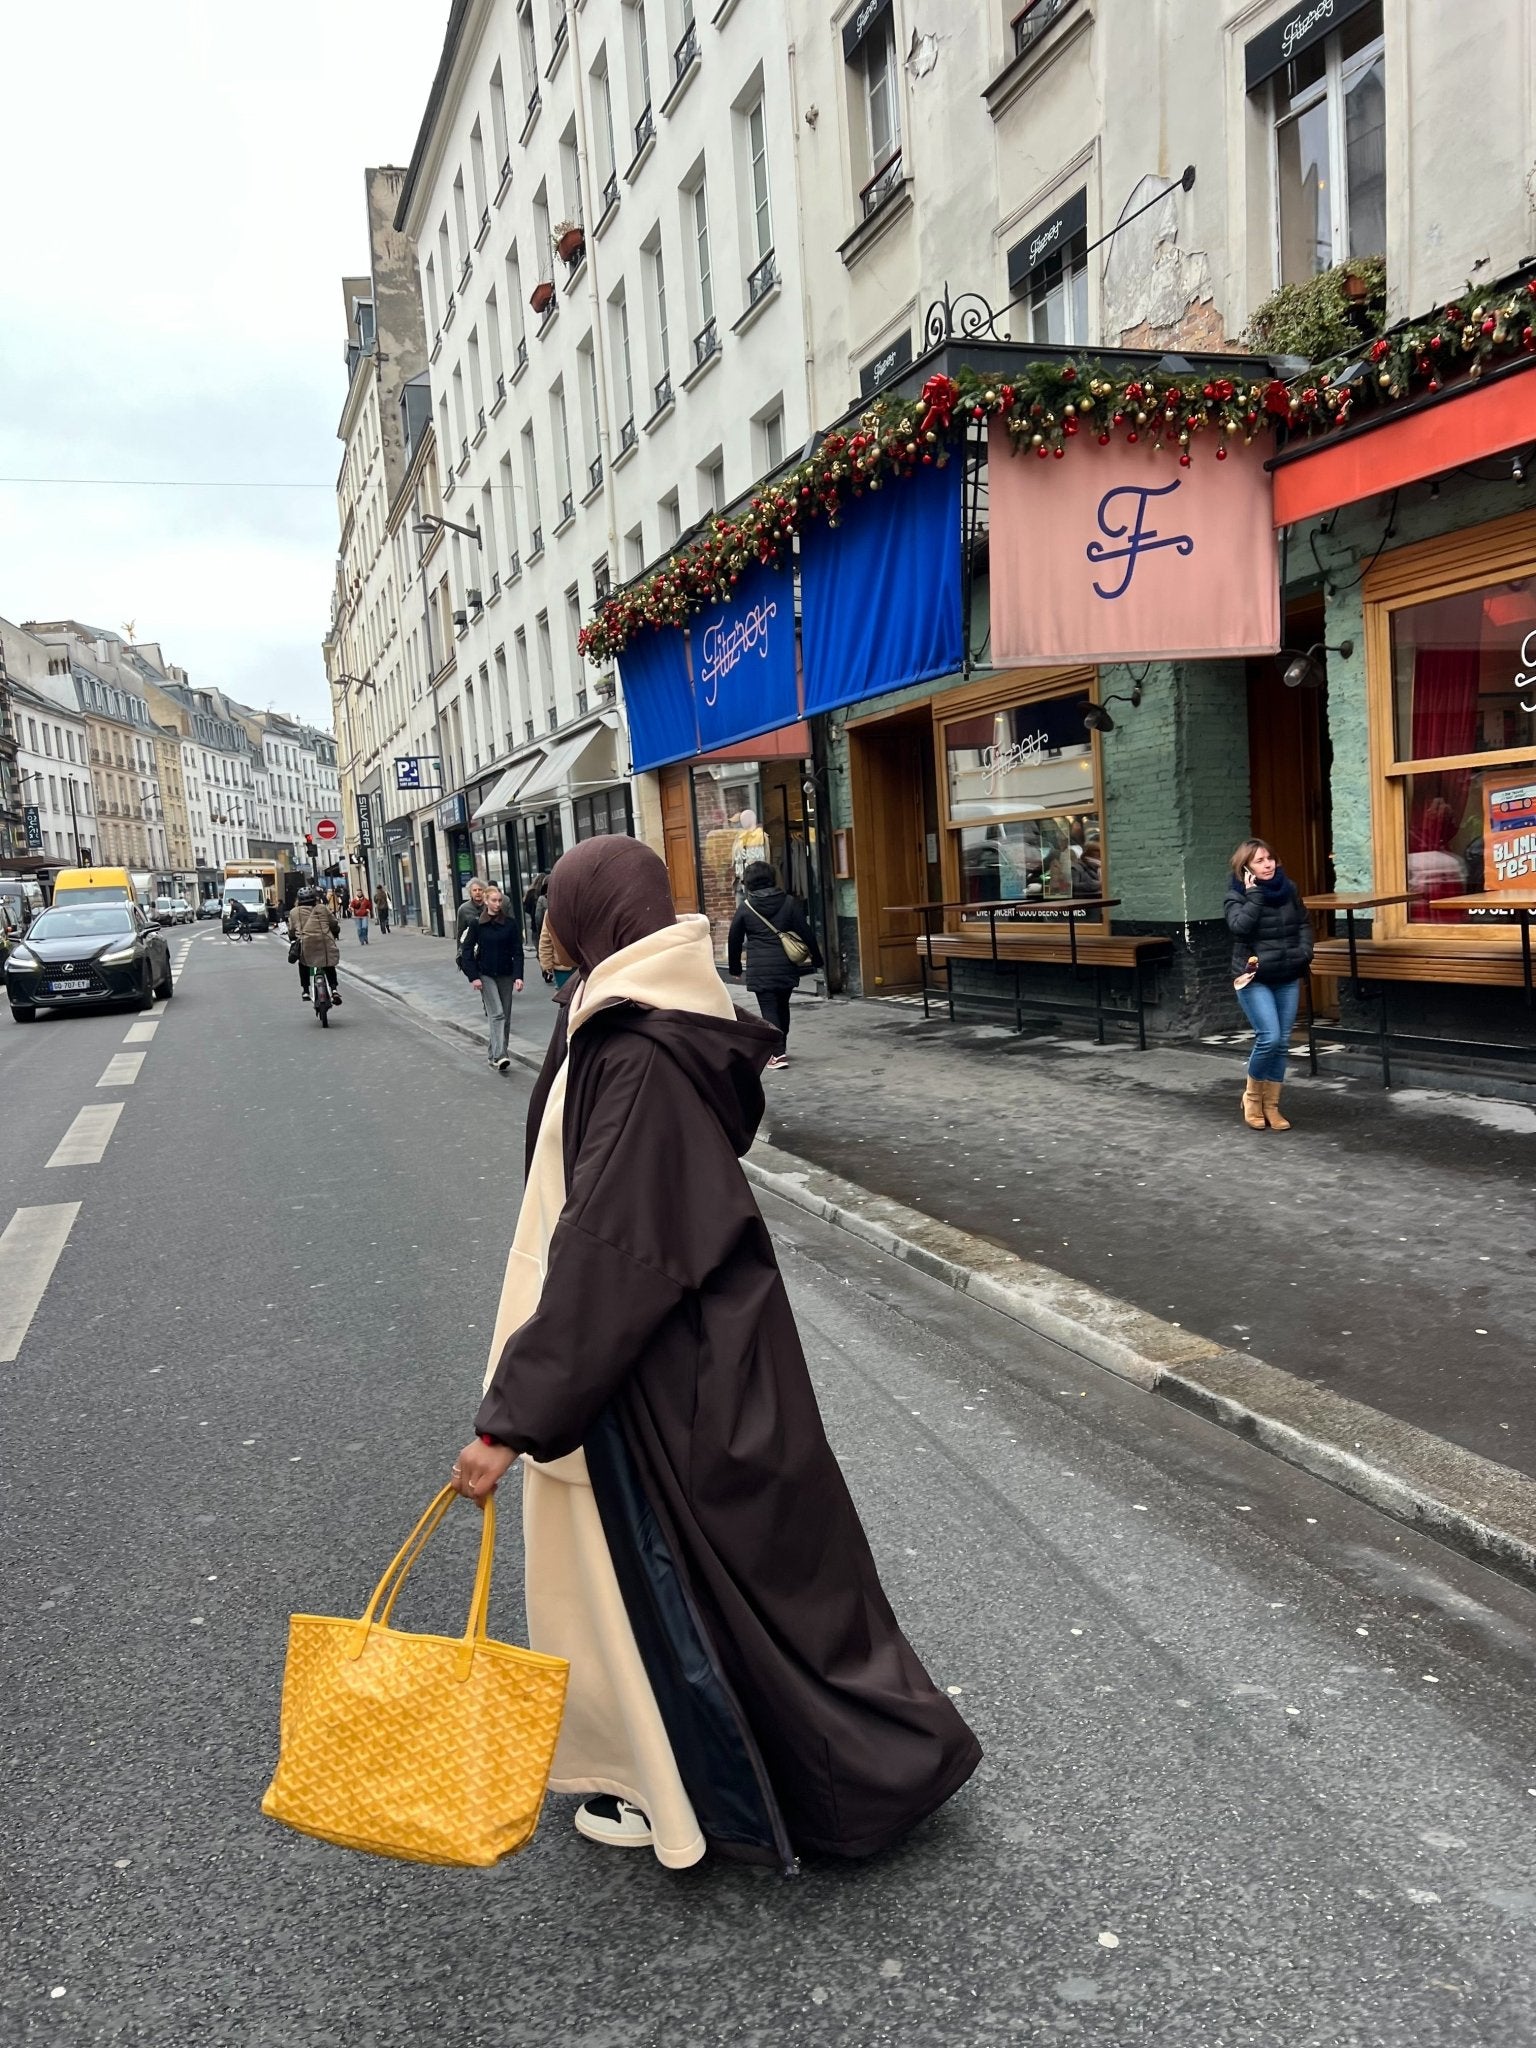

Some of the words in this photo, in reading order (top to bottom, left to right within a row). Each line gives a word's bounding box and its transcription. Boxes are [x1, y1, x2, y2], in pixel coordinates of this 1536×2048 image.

[1029, 220, 1063, 267] Fitzroy
[1086, 478, 1194, 600] F
[701, 595, 777, 707] Fitzroy
[397, 761, 410, 778] P
[981, 729, 1049, 796] Fitzroy
[358, 796, 371, 846] SILVERA
[988, 908, 1016, 917] NCERT
